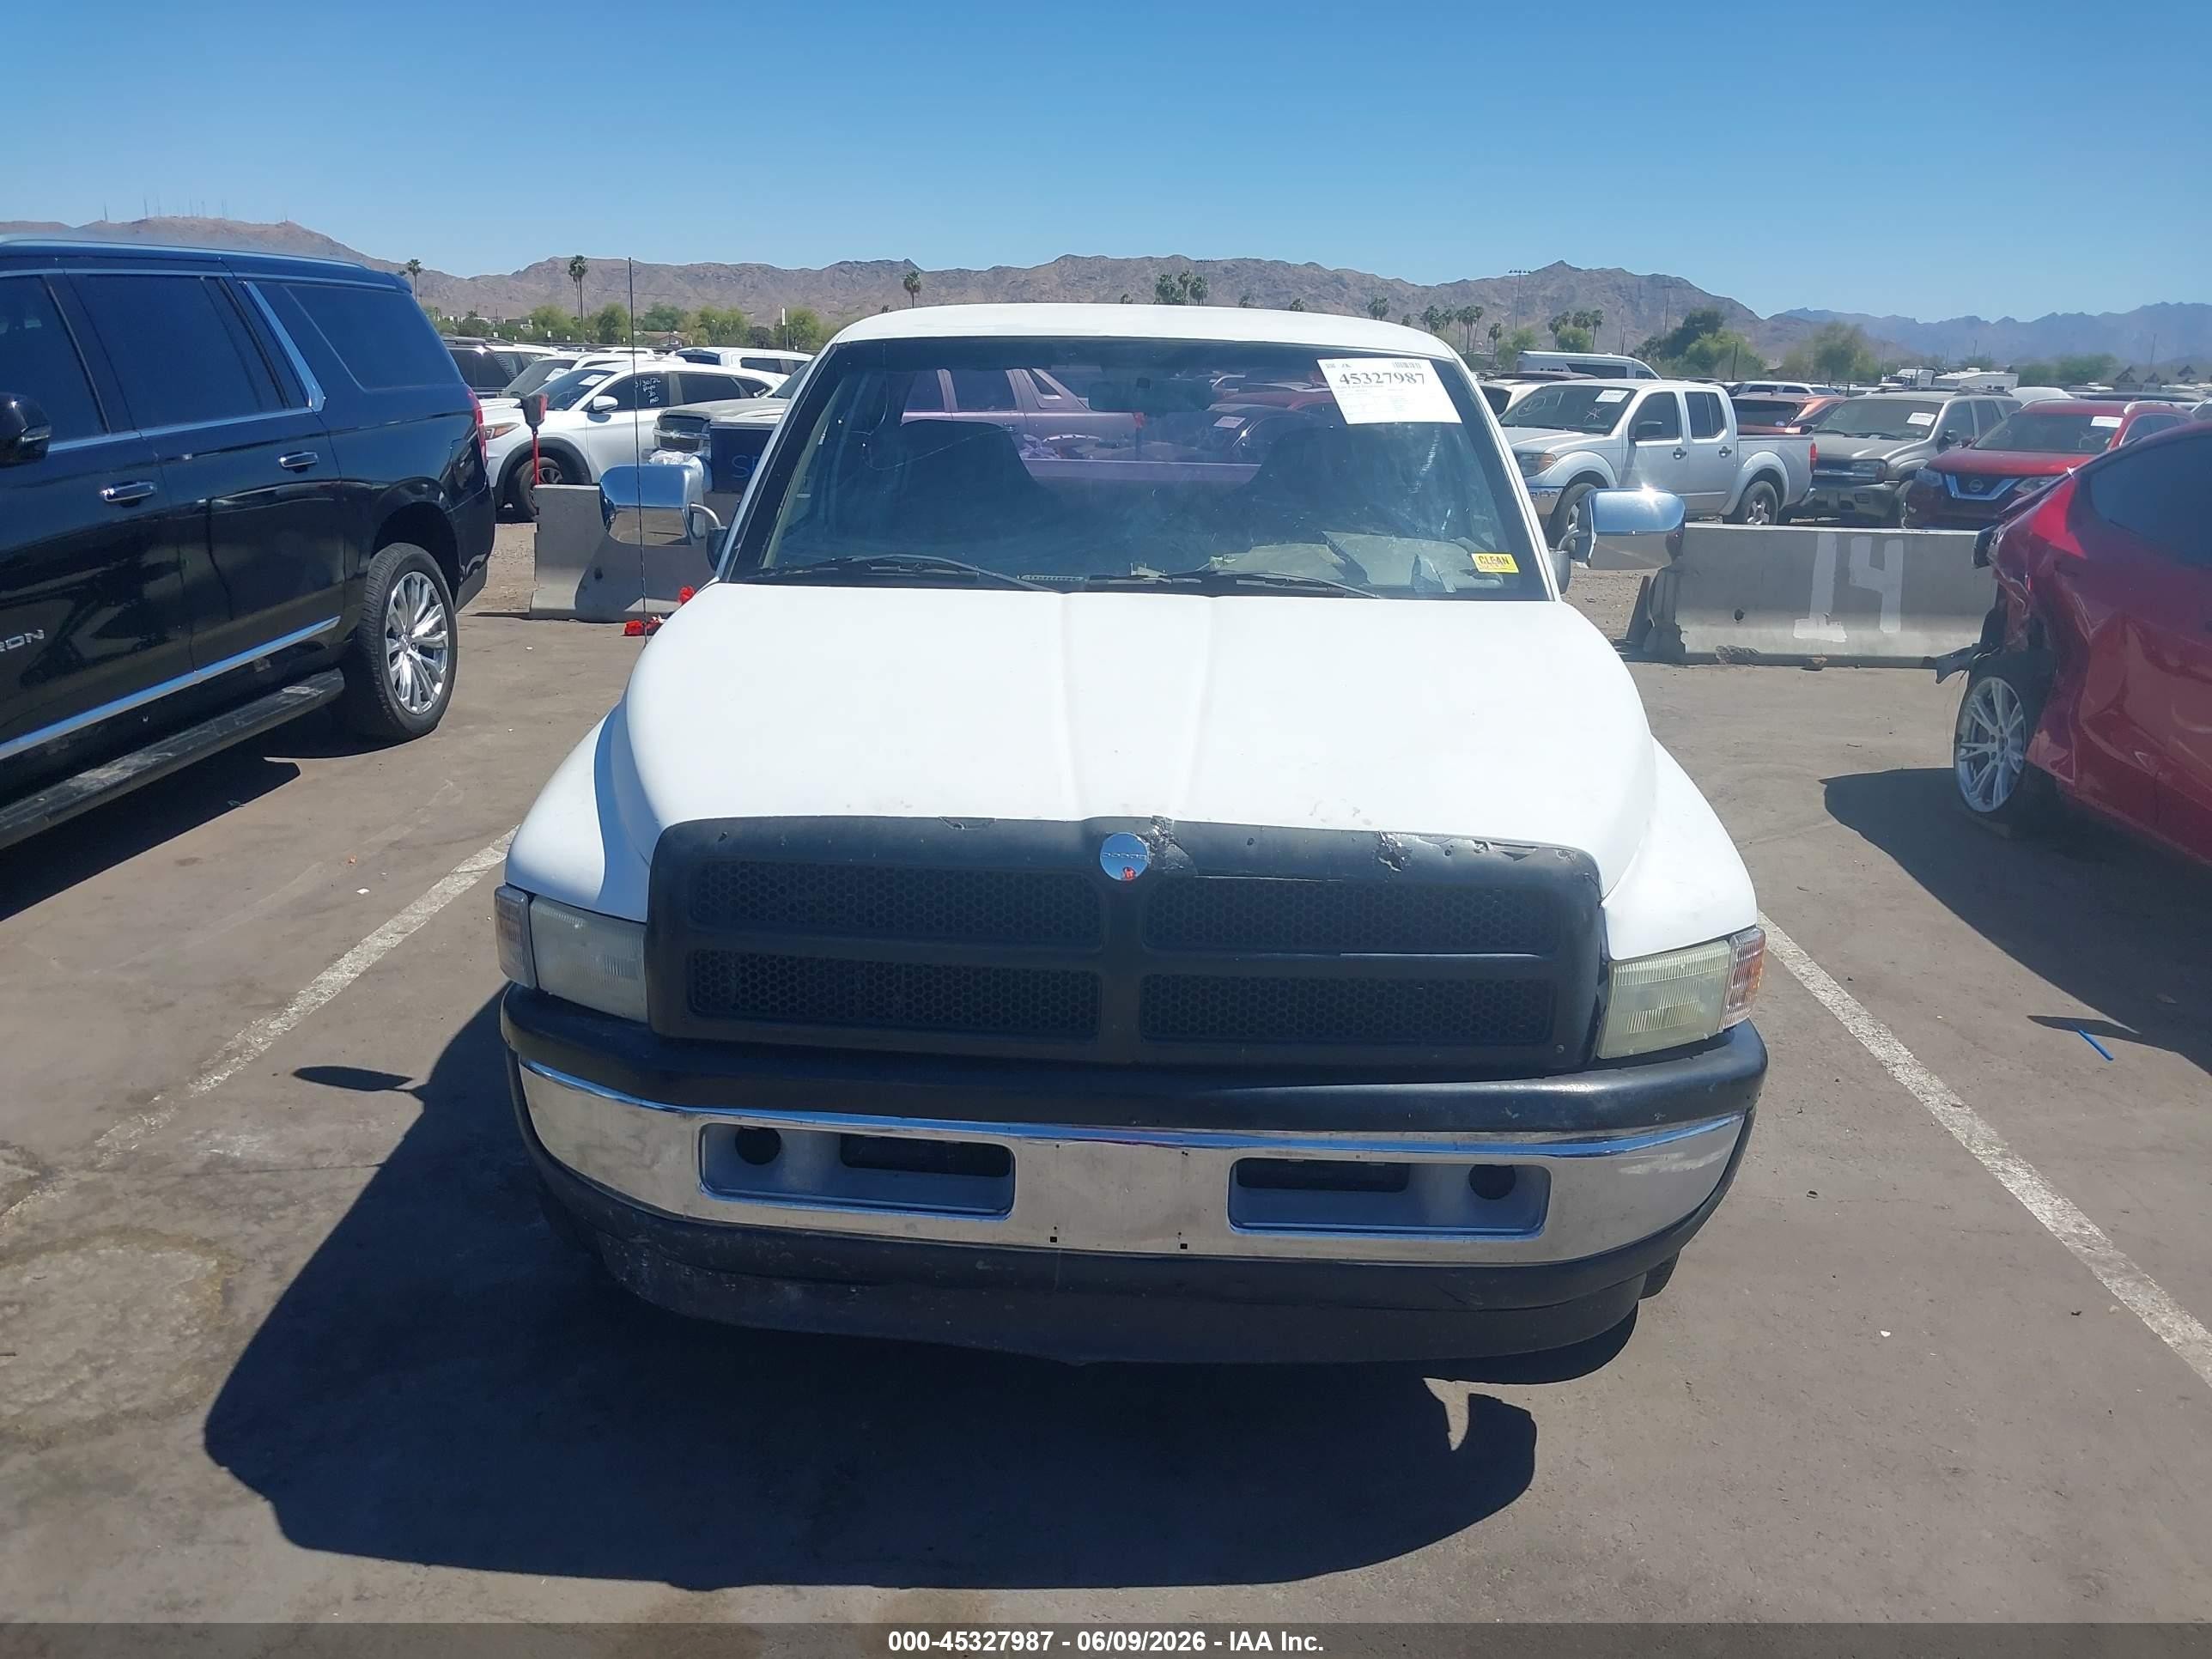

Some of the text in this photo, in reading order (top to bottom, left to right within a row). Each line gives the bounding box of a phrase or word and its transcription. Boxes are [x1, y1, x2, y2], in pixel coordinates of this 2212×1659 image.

[1339, 372, 1425, 385] 45327987
[1478, 556, 1510, 565] CLEAN
[1793, 532, 1904, 643] 14
